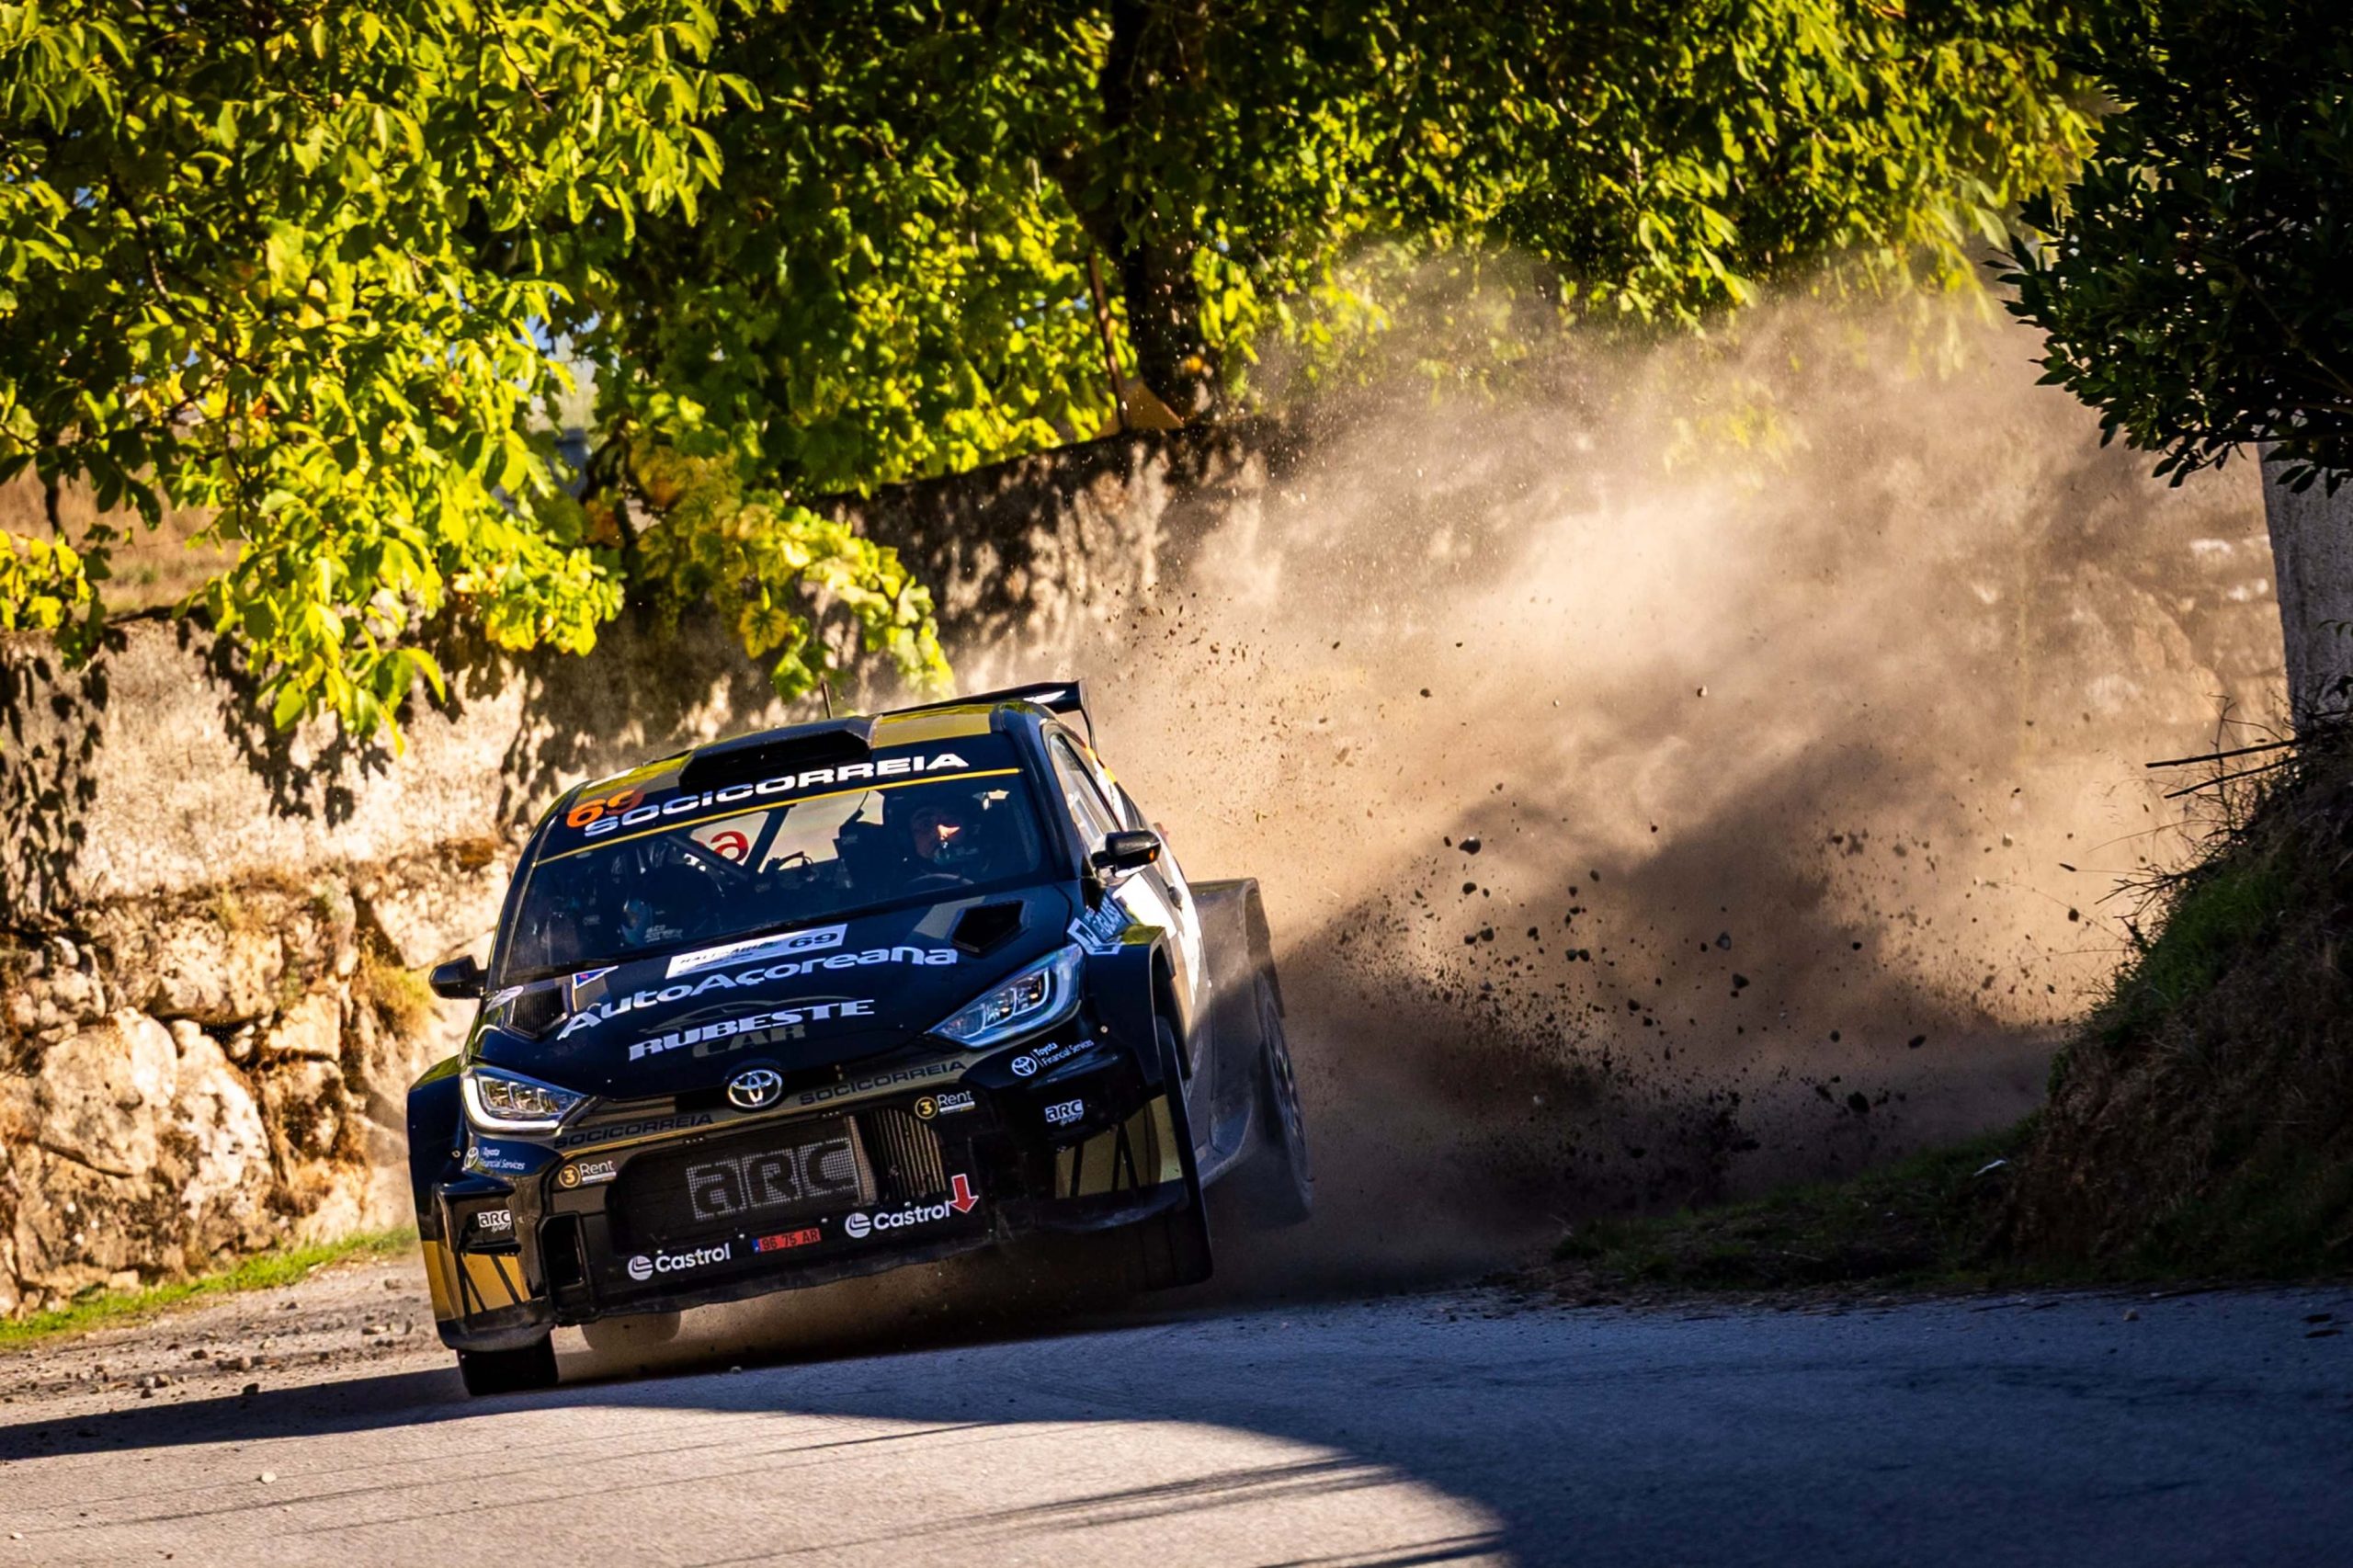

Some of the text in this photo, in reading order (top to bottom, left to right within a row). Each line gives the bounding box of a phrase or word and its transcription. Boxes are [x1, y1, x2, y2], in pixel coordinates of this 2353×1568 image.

[566, 790, 644, 828] 69
[584, 753, 970, 837] SOCICORREIA
[788, 932, 838, 949] 69
[557, 946, 958, 1040] AutoAçoreana
[629, 999, 875, 1062] RUBESTE
[692, 1024, 806, 1058] CAR
[800, 1060, 967, 1105] SOCICORREIA
[937, 1090, 974, 1107] Rent
[553, 1113, 714, 1150] SOCICORREIA
[579, 1160, 615, 1176] Rent
[873, 1200, 950, 1231] Castrol
[802, 1229, 818, 1243] AR
[655, 1242, 731, 1274] Castrol
